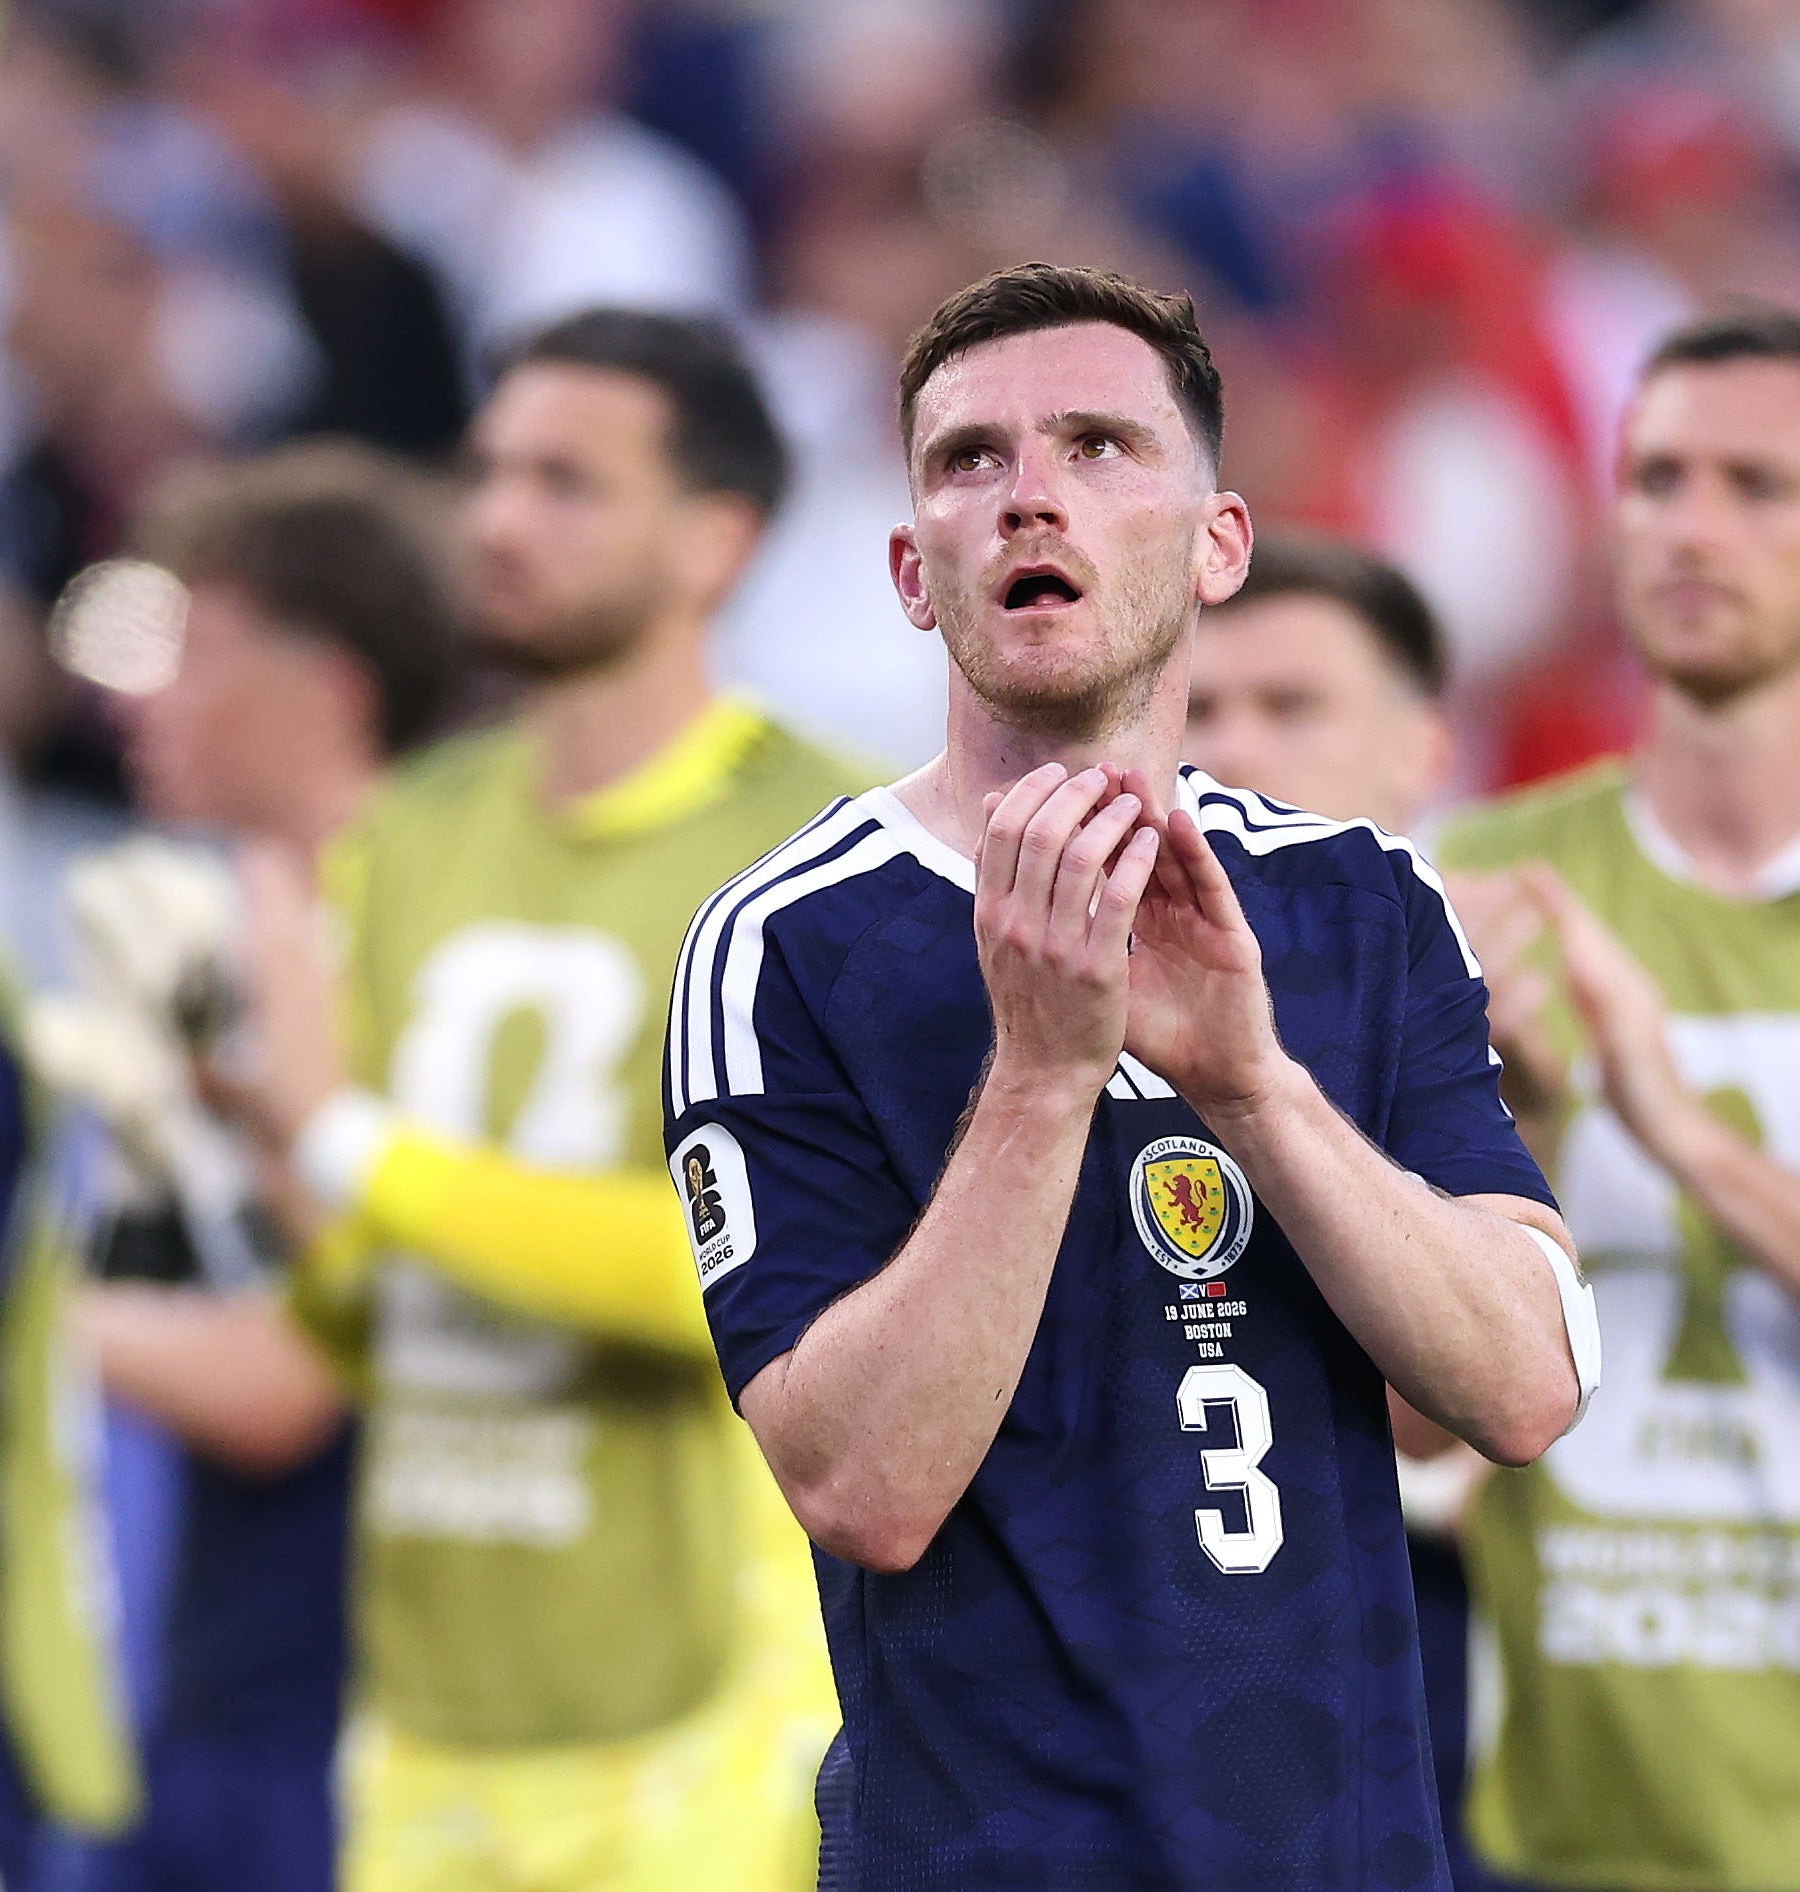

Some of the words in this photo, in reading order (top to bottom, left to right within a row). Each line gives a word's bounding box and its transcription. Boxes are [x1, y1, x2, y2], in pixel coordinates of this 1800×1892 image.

[1145, 1139, 1207, 1160] SCOTLAND
[699, 1218, 716, 1237] FIFA
[699, 1241, 717, 1260] WORLD
[716, 1234, 731, 1248] CUP
[1155, 1248, 1172, 1266] EST
[1225, 1241, 1243, 1263] 1873
[700, 1245, 734, 1276] 2026
[1164, 1305, 1178, 1321] 19
[1181, 1303, 1215, 1320] JUNE
[1217, 1301, 1247, 1317] 2026
[1184, 1322, 1232, 1340] BOSTON
[1198, 1342, 1224, 1358] USA
[1176, 1363, 1284, 1575] 3
